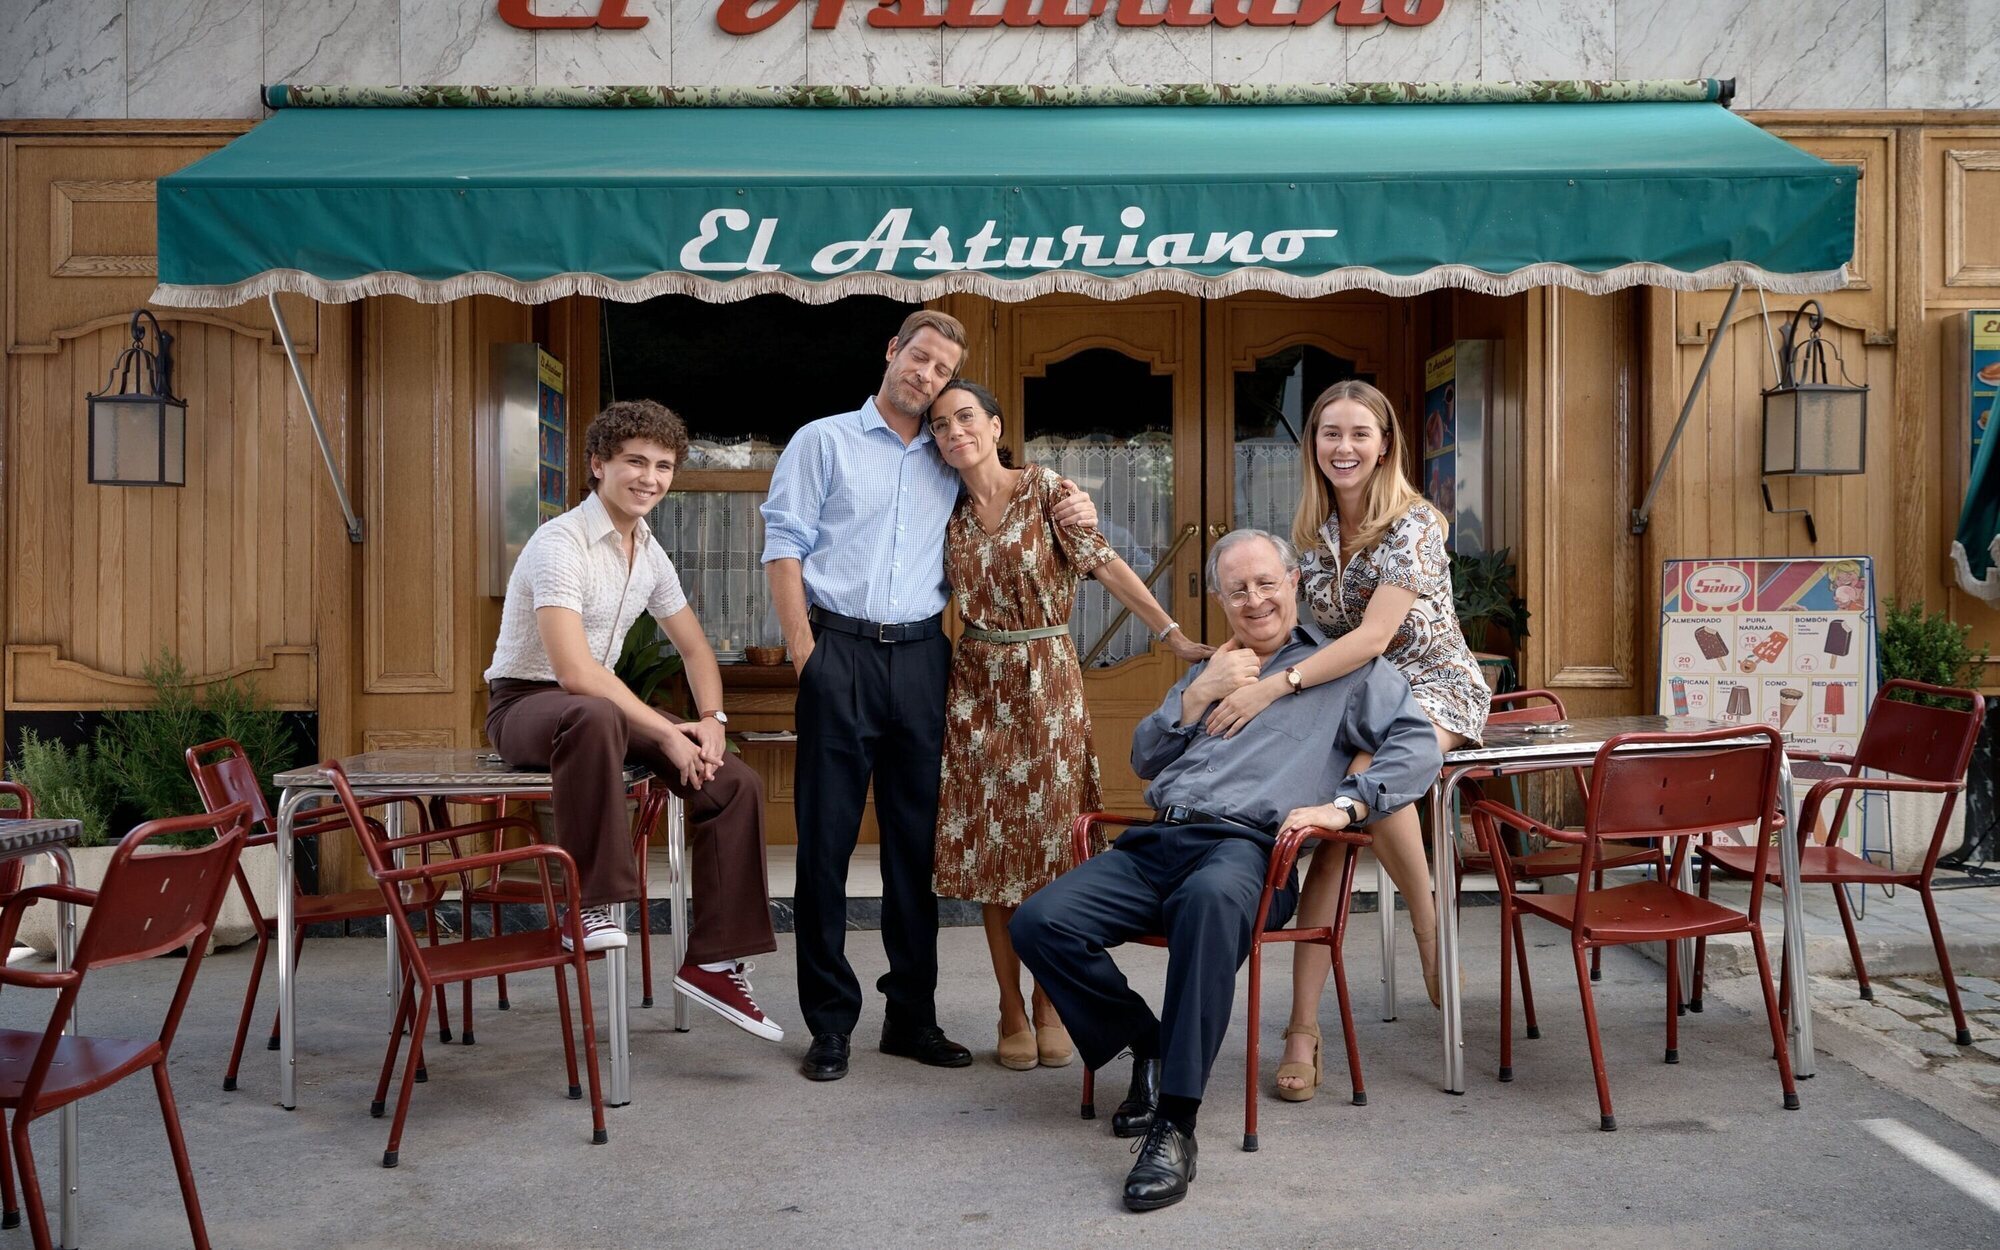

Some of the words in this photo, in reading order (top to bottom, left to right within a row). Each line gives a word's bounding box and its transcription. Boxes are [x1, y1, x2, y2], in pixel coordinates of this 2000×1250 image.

[680, 208, 781, 271] El
[811, 206, 1338, 274] Asturiano
[1695, 579, 1741, 593] Sainz
